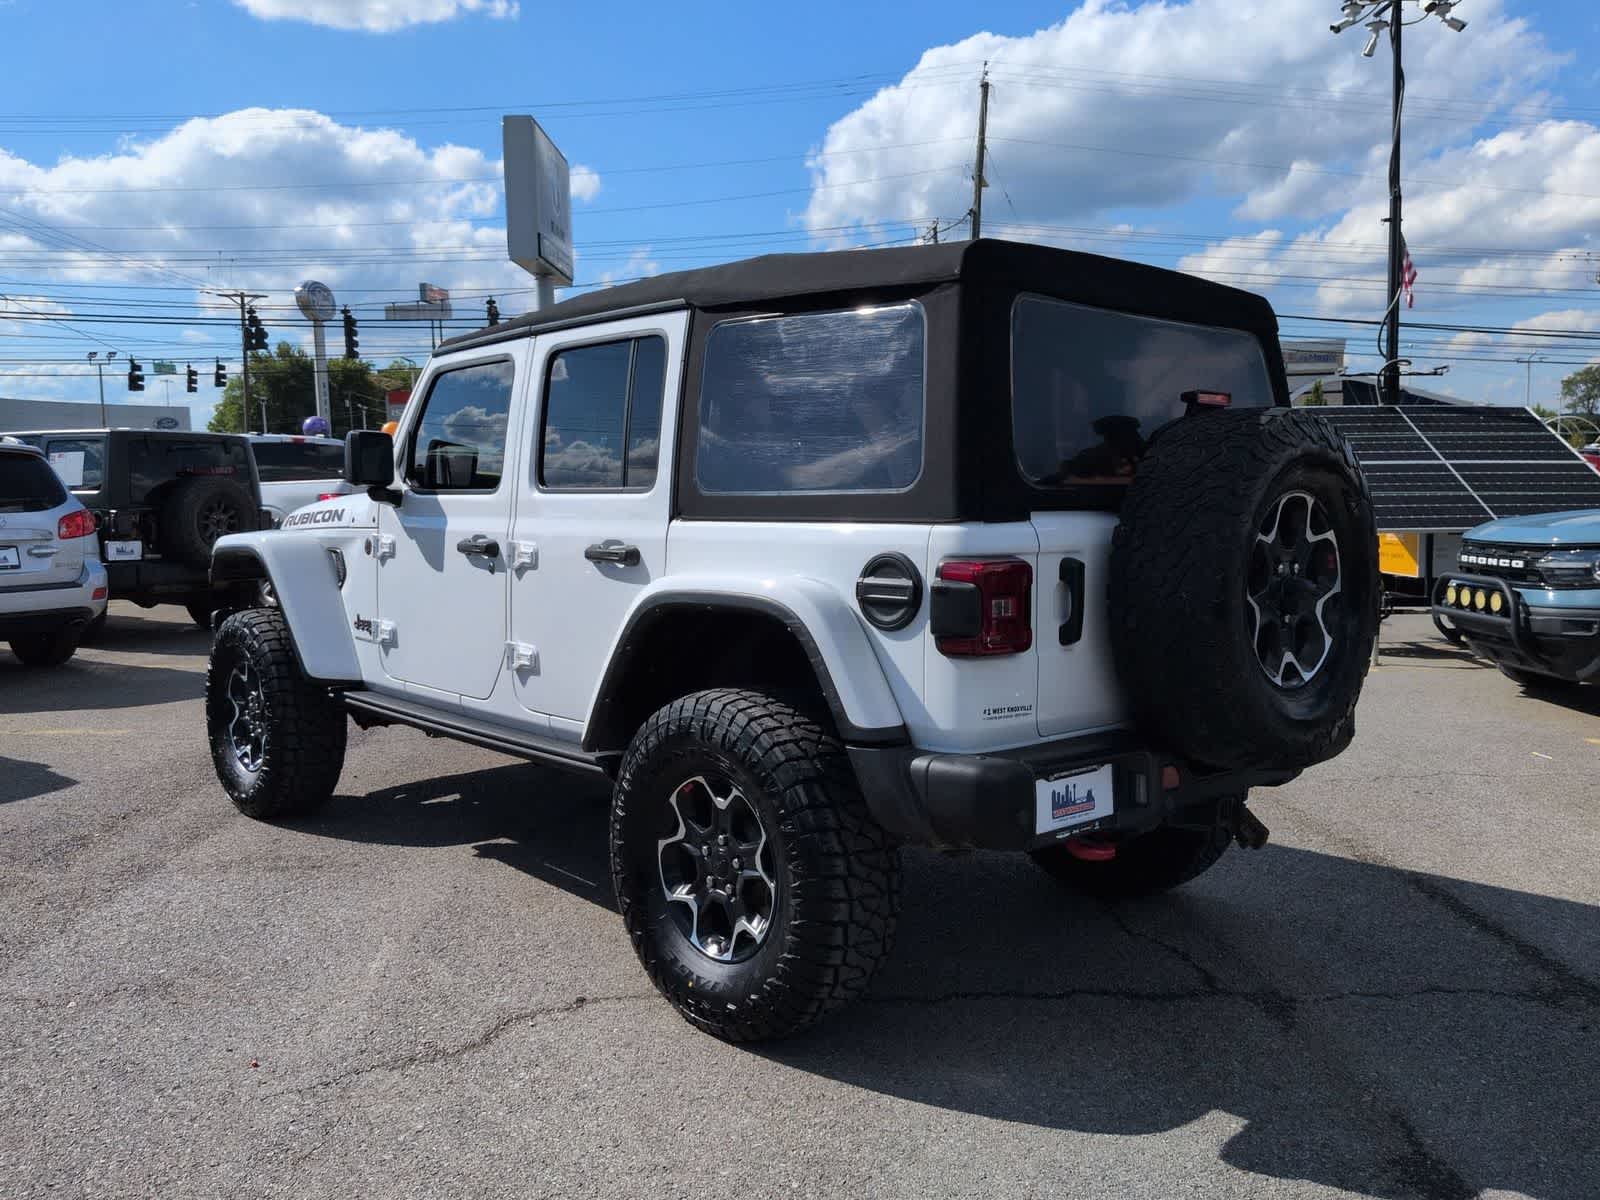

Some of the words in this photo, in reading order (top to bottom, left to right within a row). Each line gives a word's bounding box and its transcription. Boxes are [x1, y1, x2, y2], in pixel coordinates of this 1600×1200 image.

[285, 508, 345, 527] RUBICON
[1461, 554, 1524, 568] BRONCO
[354, 613, 372, 636] Jeep
[992, 707, 1006, 715] WEST
[1007, 704, 1032, 713] KNOXVILLE
